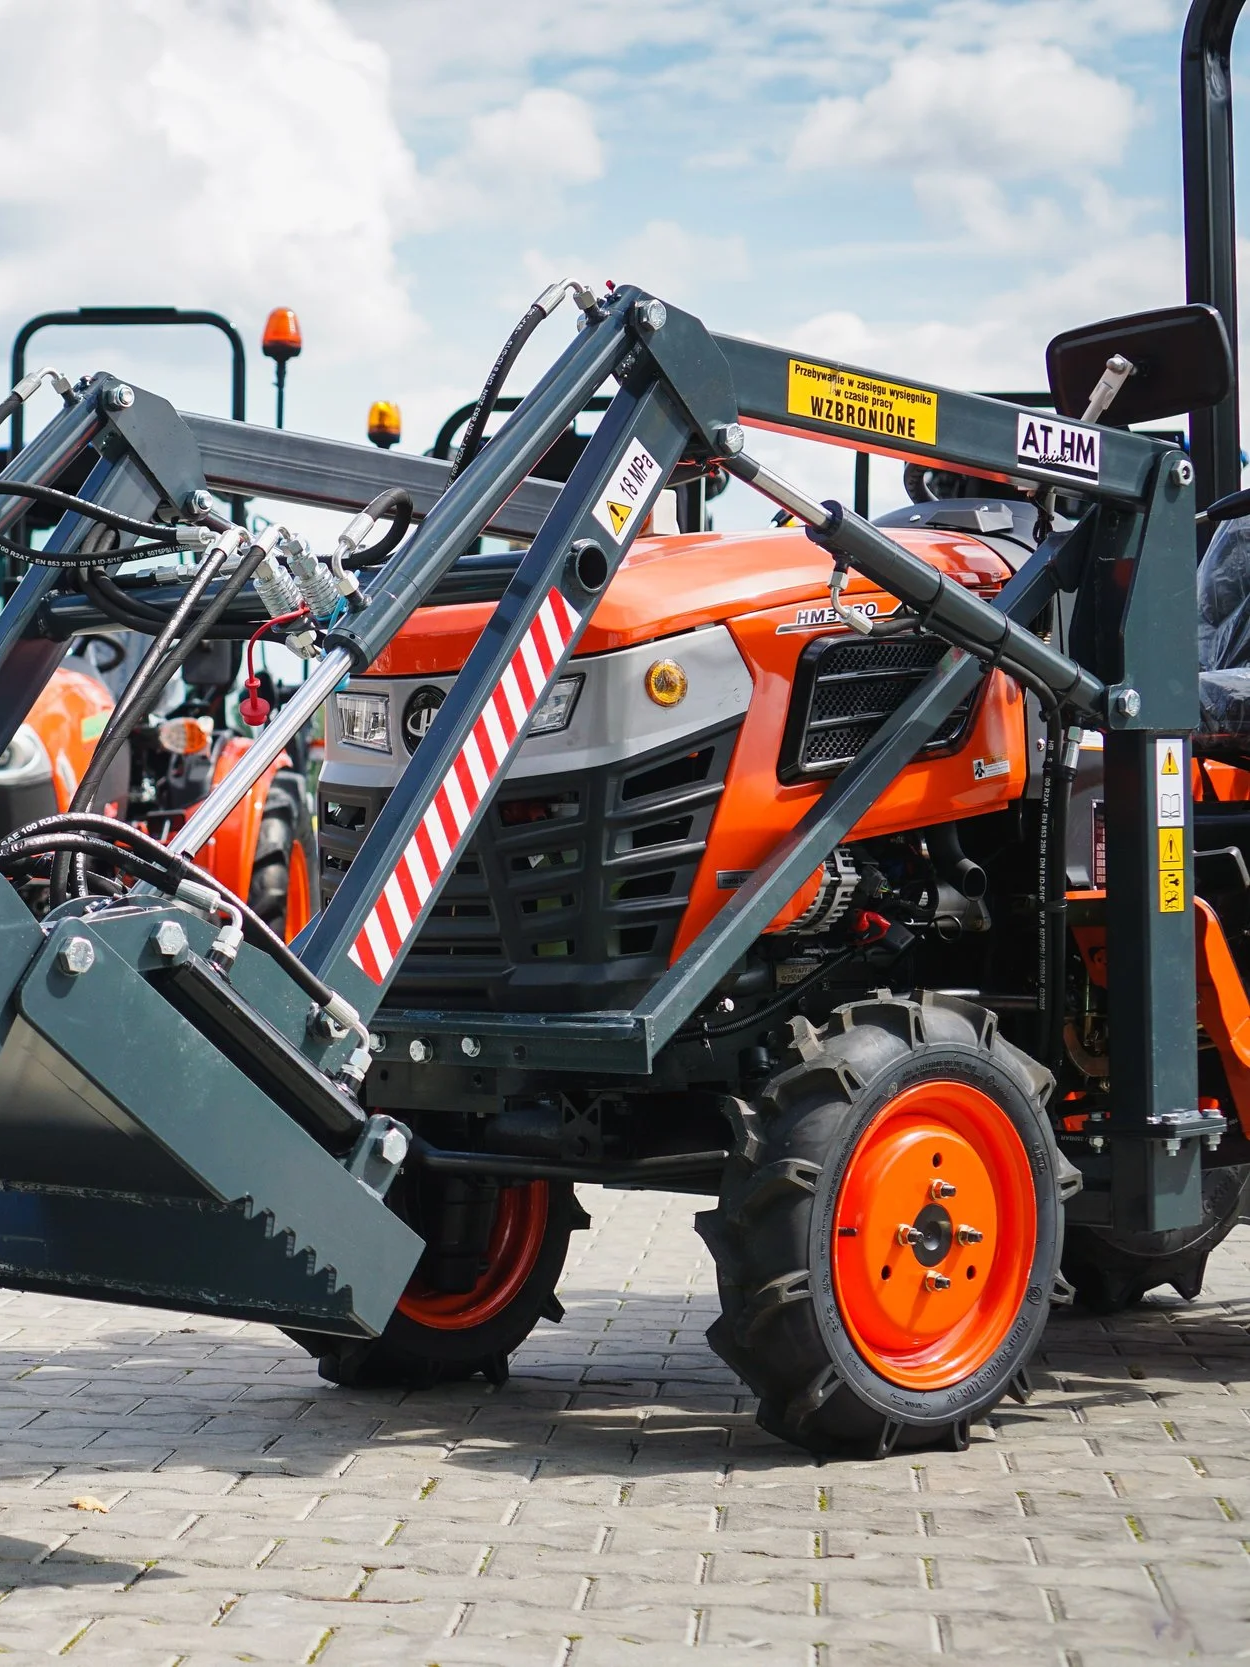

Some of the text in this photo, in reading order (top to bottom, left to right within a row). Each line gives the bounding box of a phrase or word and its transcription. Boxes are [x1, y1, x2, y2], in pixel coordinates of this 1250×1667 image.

[794, 363, 932, 406] Przebywanie w zasięgu wysięgnika
[834, 388, 894, 411] w czasie pracy
[810, 395, 916, 438] WZBRONIONE
[1037, 449, 1071, 464] mini
[1060, 429, 1096, 467] HM
[619, 453, 654, 501] 18 MPa
[9, 550, 30, 562] R2AT
[35, 558, 46, 566] EN
[1042, 787, 1051, 808] R2AT
[21, 822, 38, 835] 100
[38, 814, 66, 827] R2AT
